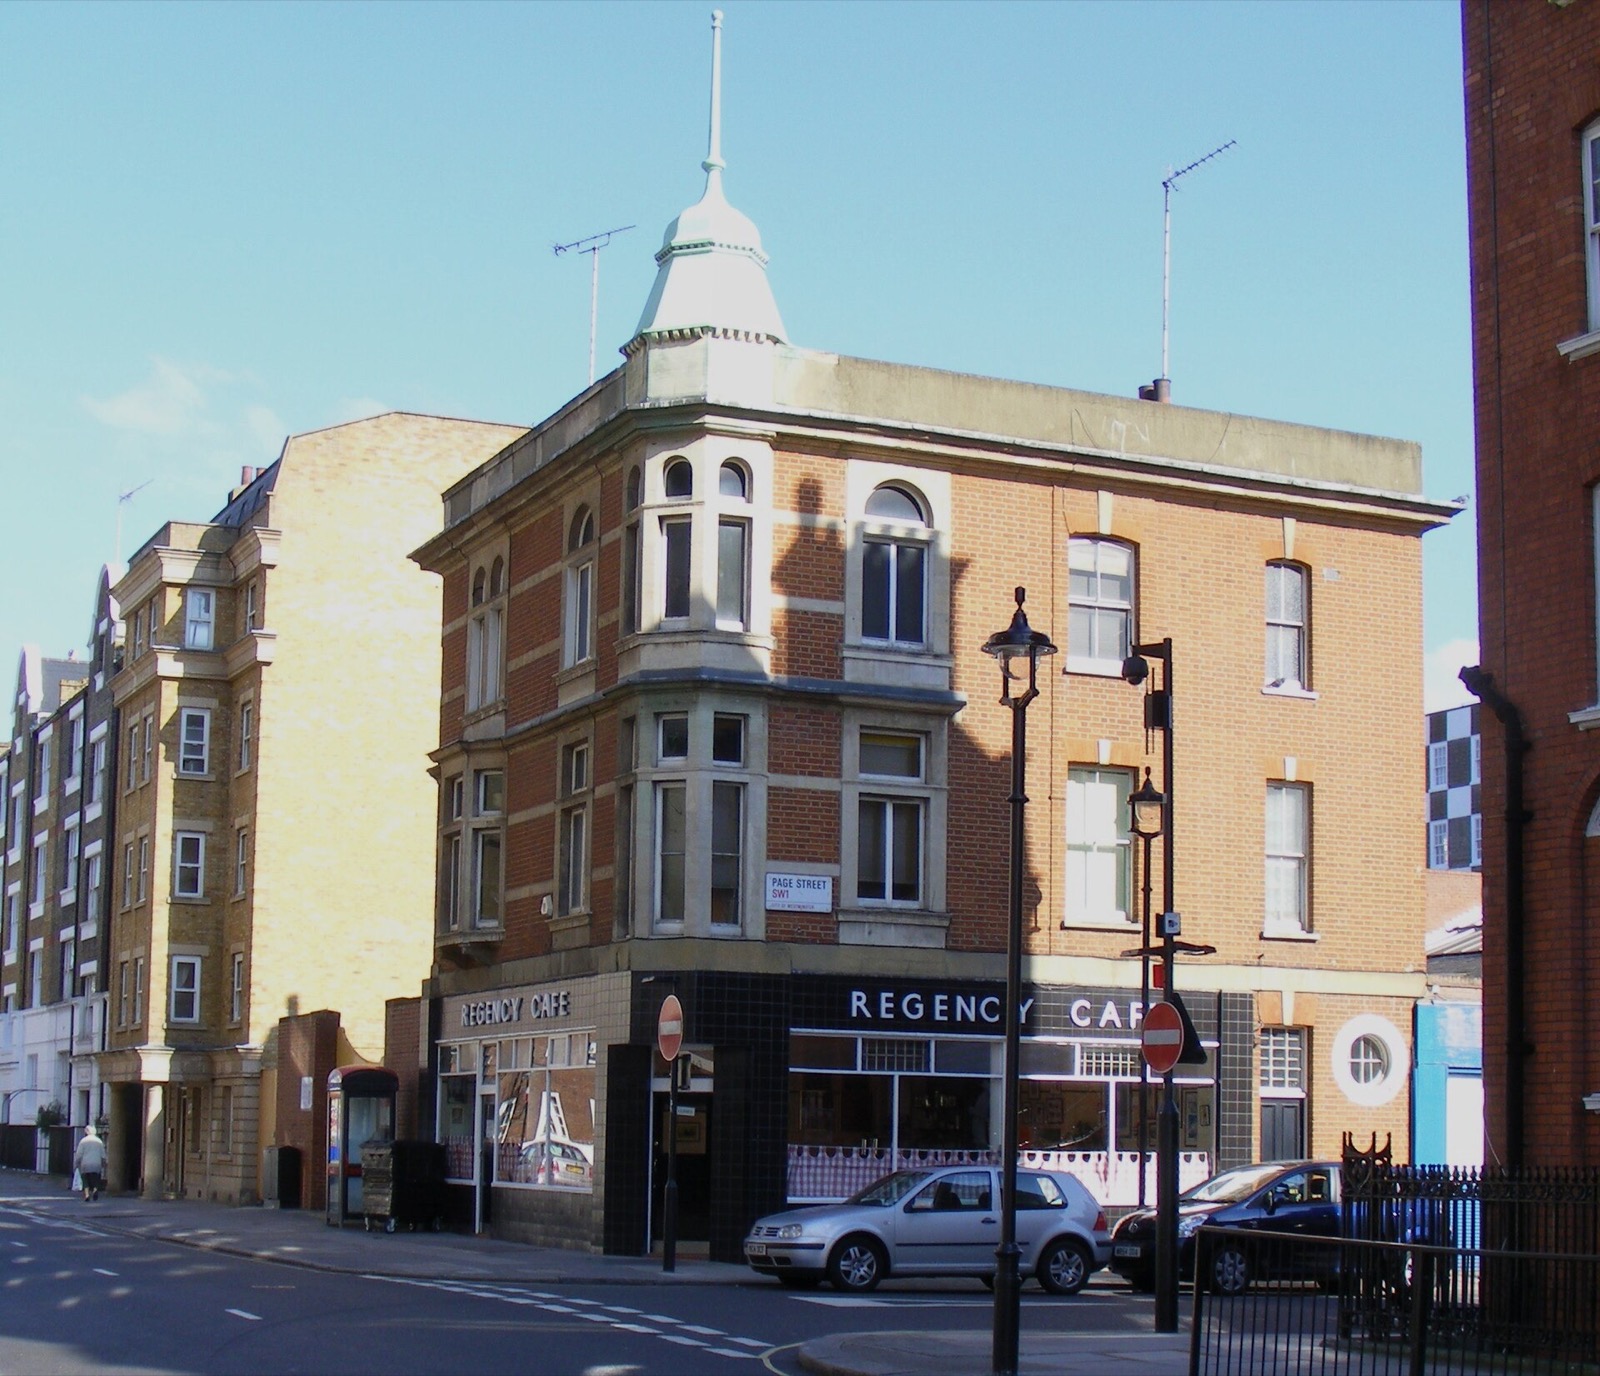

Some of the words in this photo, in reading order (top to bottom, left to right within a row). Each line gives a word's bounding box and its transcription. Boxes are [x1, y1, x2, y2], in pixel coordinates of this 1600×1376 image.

[772, 877, 793, 888] PAGE
[796, 879, 827, 890] STREET
[772, 889, 789, 899] SW1
[461, 997, 523, 1027] REGENCY
[531, 991, 570, 1019] CAFE
[851, 990, 1035, 1024] REGENCY
[1070, 999, 1156, 1030] CAF
